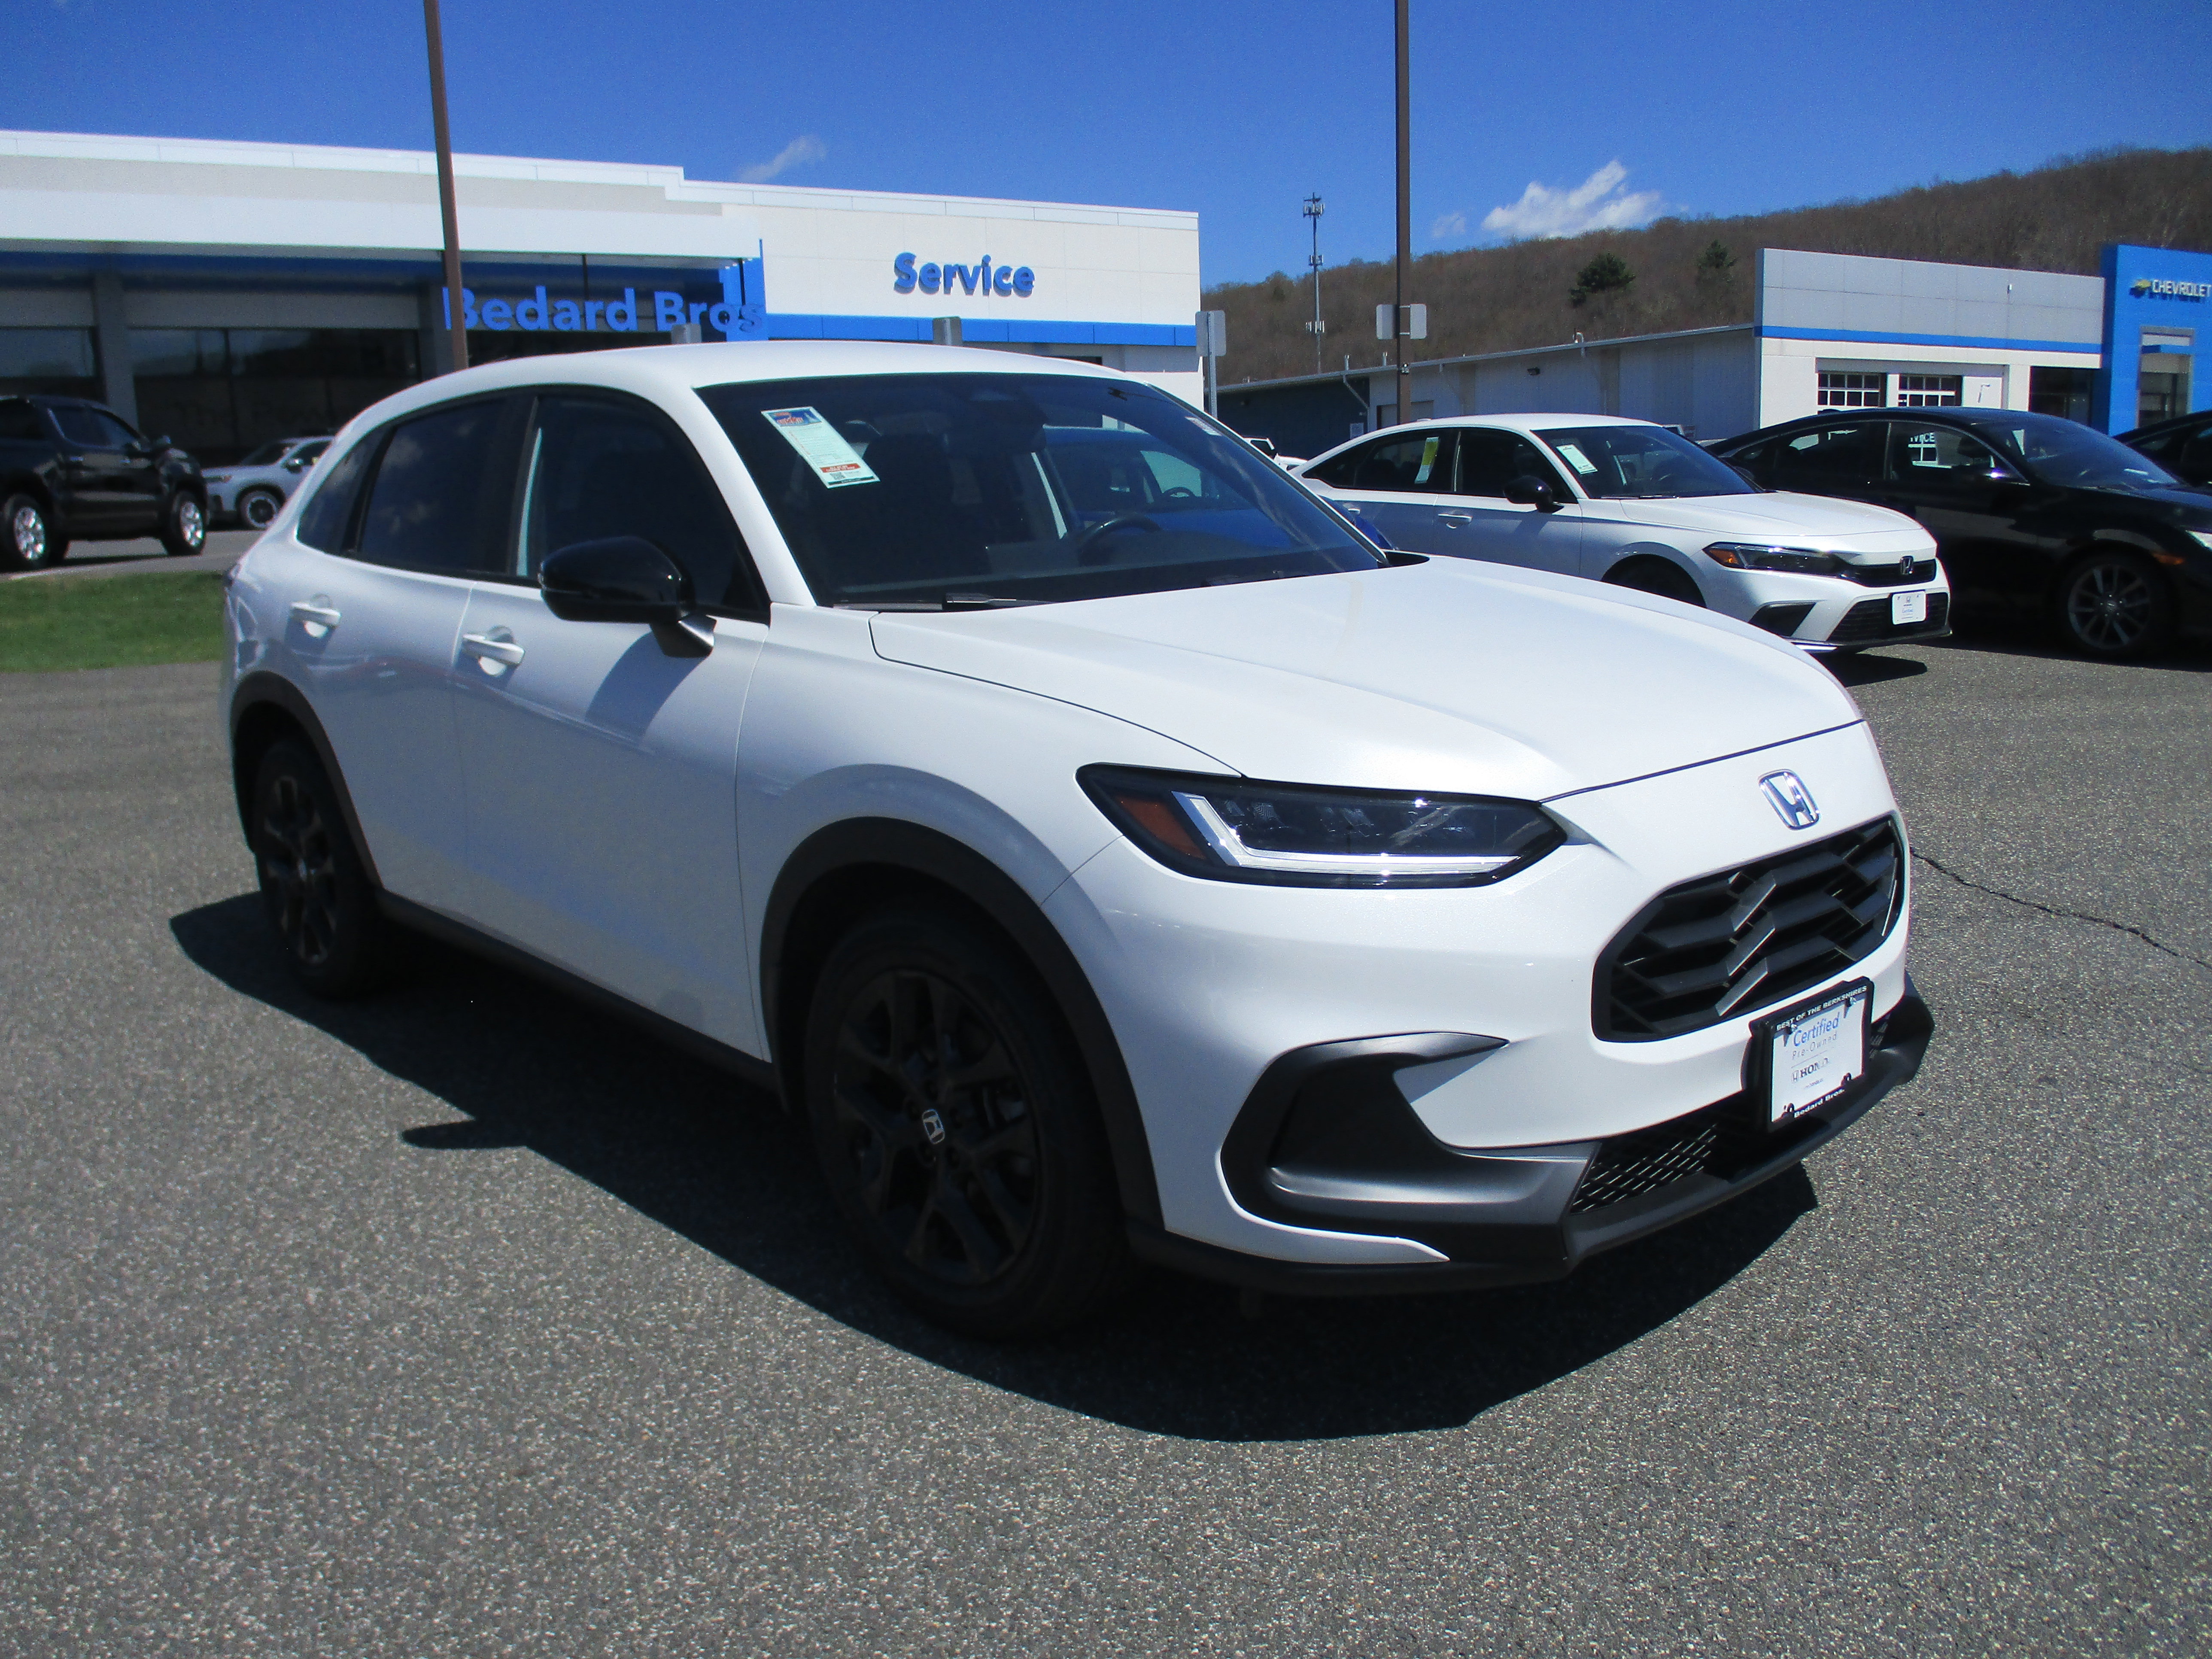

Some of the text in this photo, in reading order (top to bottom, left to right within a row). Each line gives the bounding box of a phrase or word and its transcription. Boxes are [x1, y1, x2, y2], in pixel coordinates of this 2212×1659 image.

[894, 251, 1035, 298] Service
[2152, 279, 2212, 297] CHEVROLET
[442, 285, 763, 332] Bedard Bros
[1776, 985, 1868, 1031] BEST OF THE BERKSHIRES
[1792, 1031, 1837, 1059] Pre-Owned
[1793, 1012, 1840, 1047] Certified
[1794, 1099, 1824, 1118] Bedard
